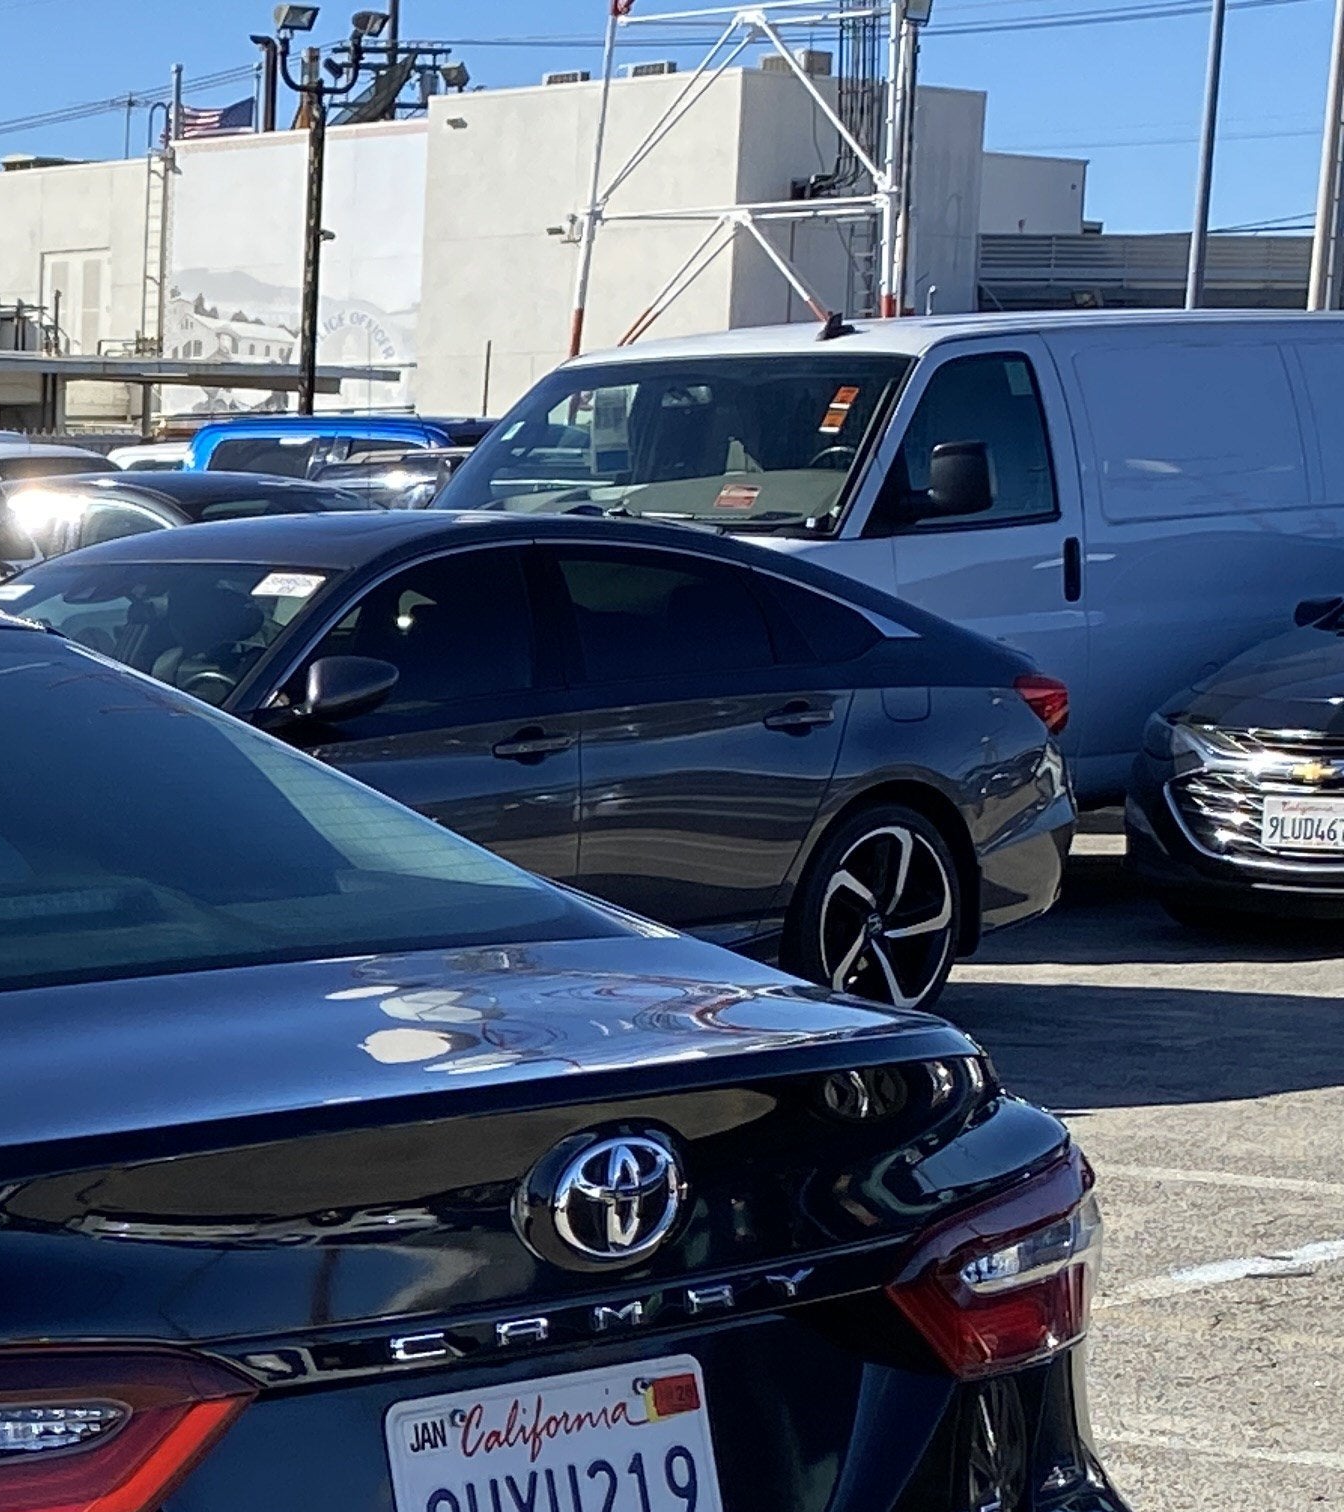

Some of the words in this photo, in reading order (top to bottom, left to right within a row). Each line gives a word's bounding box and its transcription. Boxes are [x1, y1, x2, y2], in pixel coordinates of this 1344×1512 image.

[390, 1267, 814, 1360] CAMRY
[410, 1419, 448, 1452] JAN
[462, 1388, 649, 1463] California
